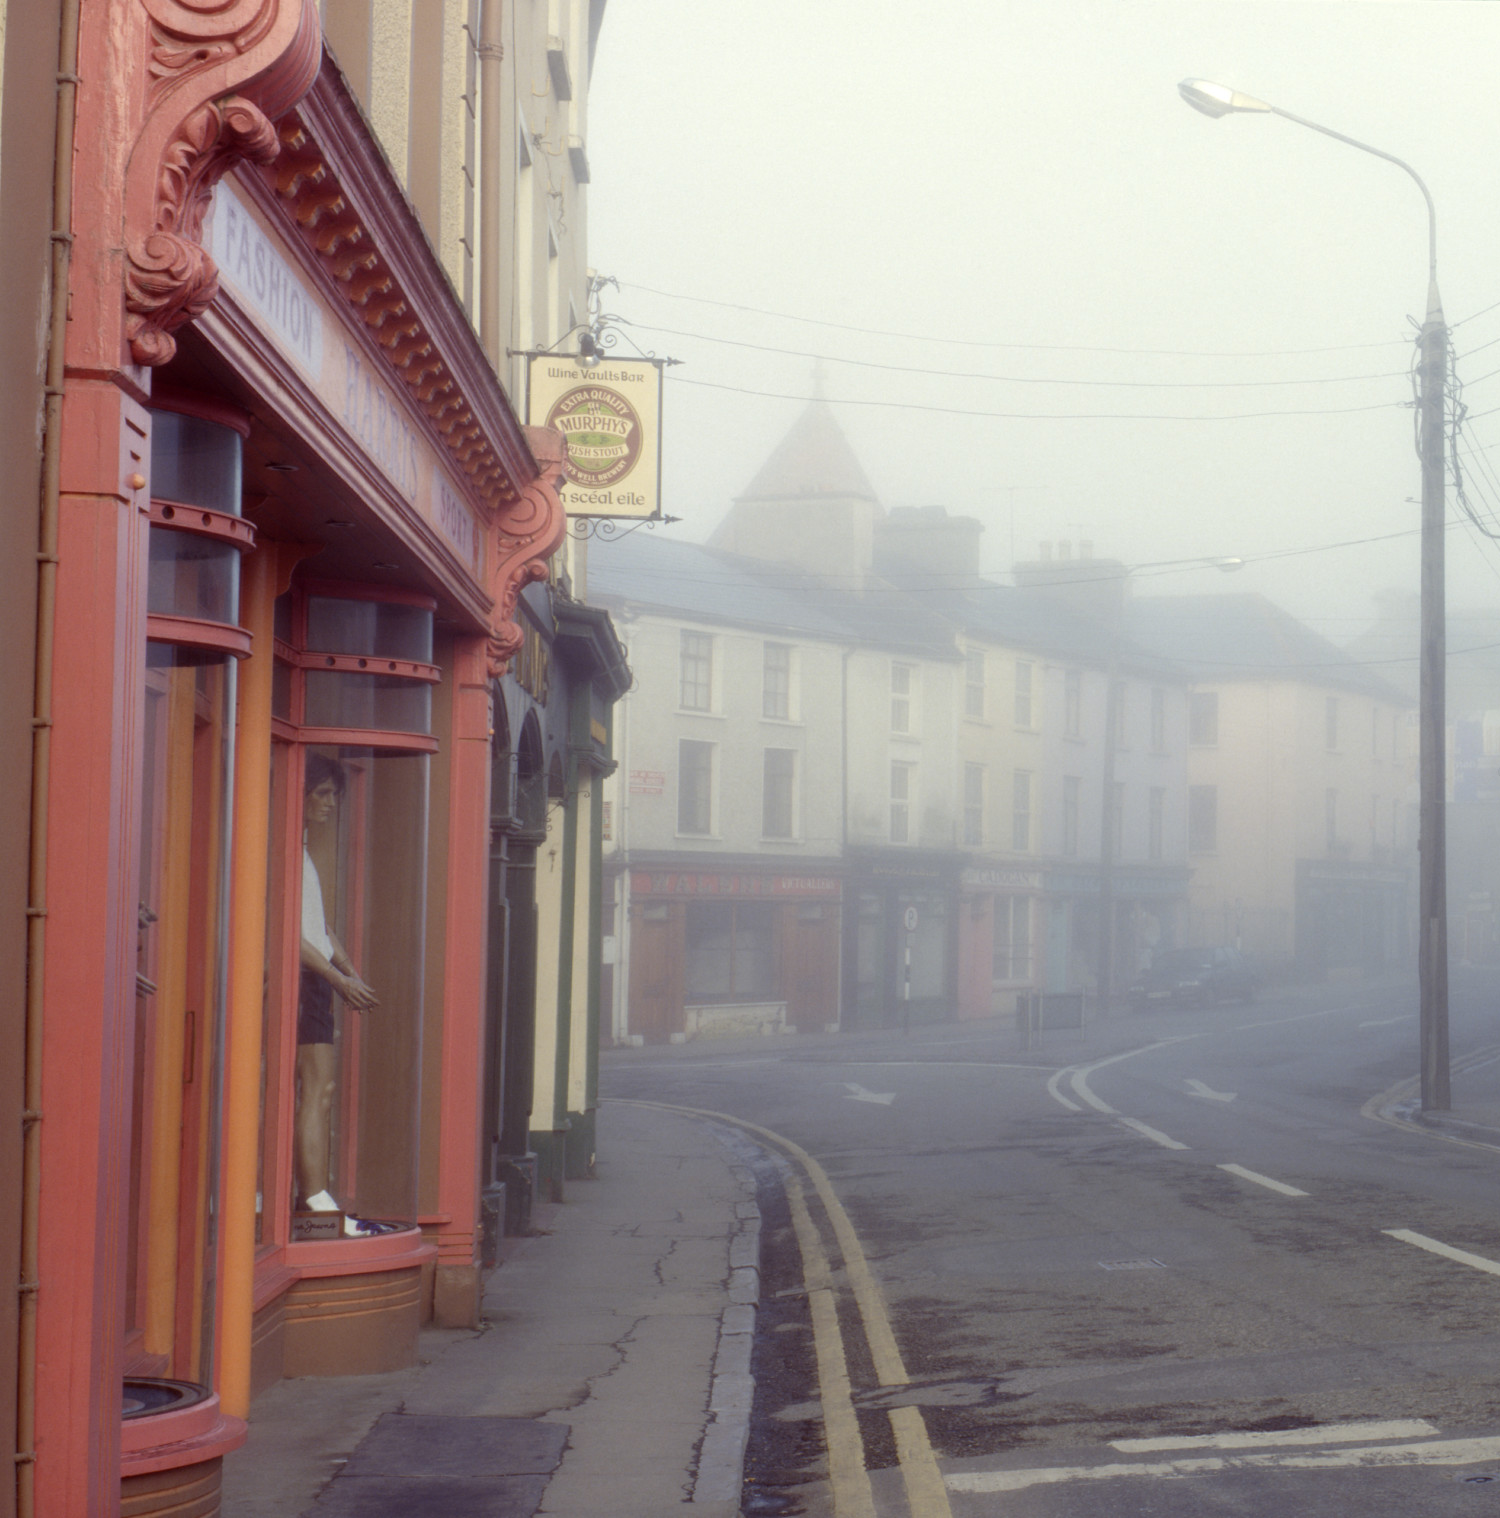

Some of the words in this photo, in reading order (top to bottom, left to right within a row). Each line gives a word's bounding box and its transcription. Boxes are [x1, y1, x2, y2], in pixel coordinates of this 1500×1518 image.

[225, 206, 313, 360] FASHION
[547, 367, 578, 380] Wine
[580, 369, 619, 382] Vaults
[560, 391, 590, 412] EXTRA
[590, 389, 630, 415] QUALITY
[568, 445, 591, 456] RISH
[593, 446, 624, 456] STOUT
[577, 471, 597, 481] WELL
[597, 459, 627, 481] BREWERY
[570, 490, 613, 505] scéal
[617, 493, 645, 505] eile
